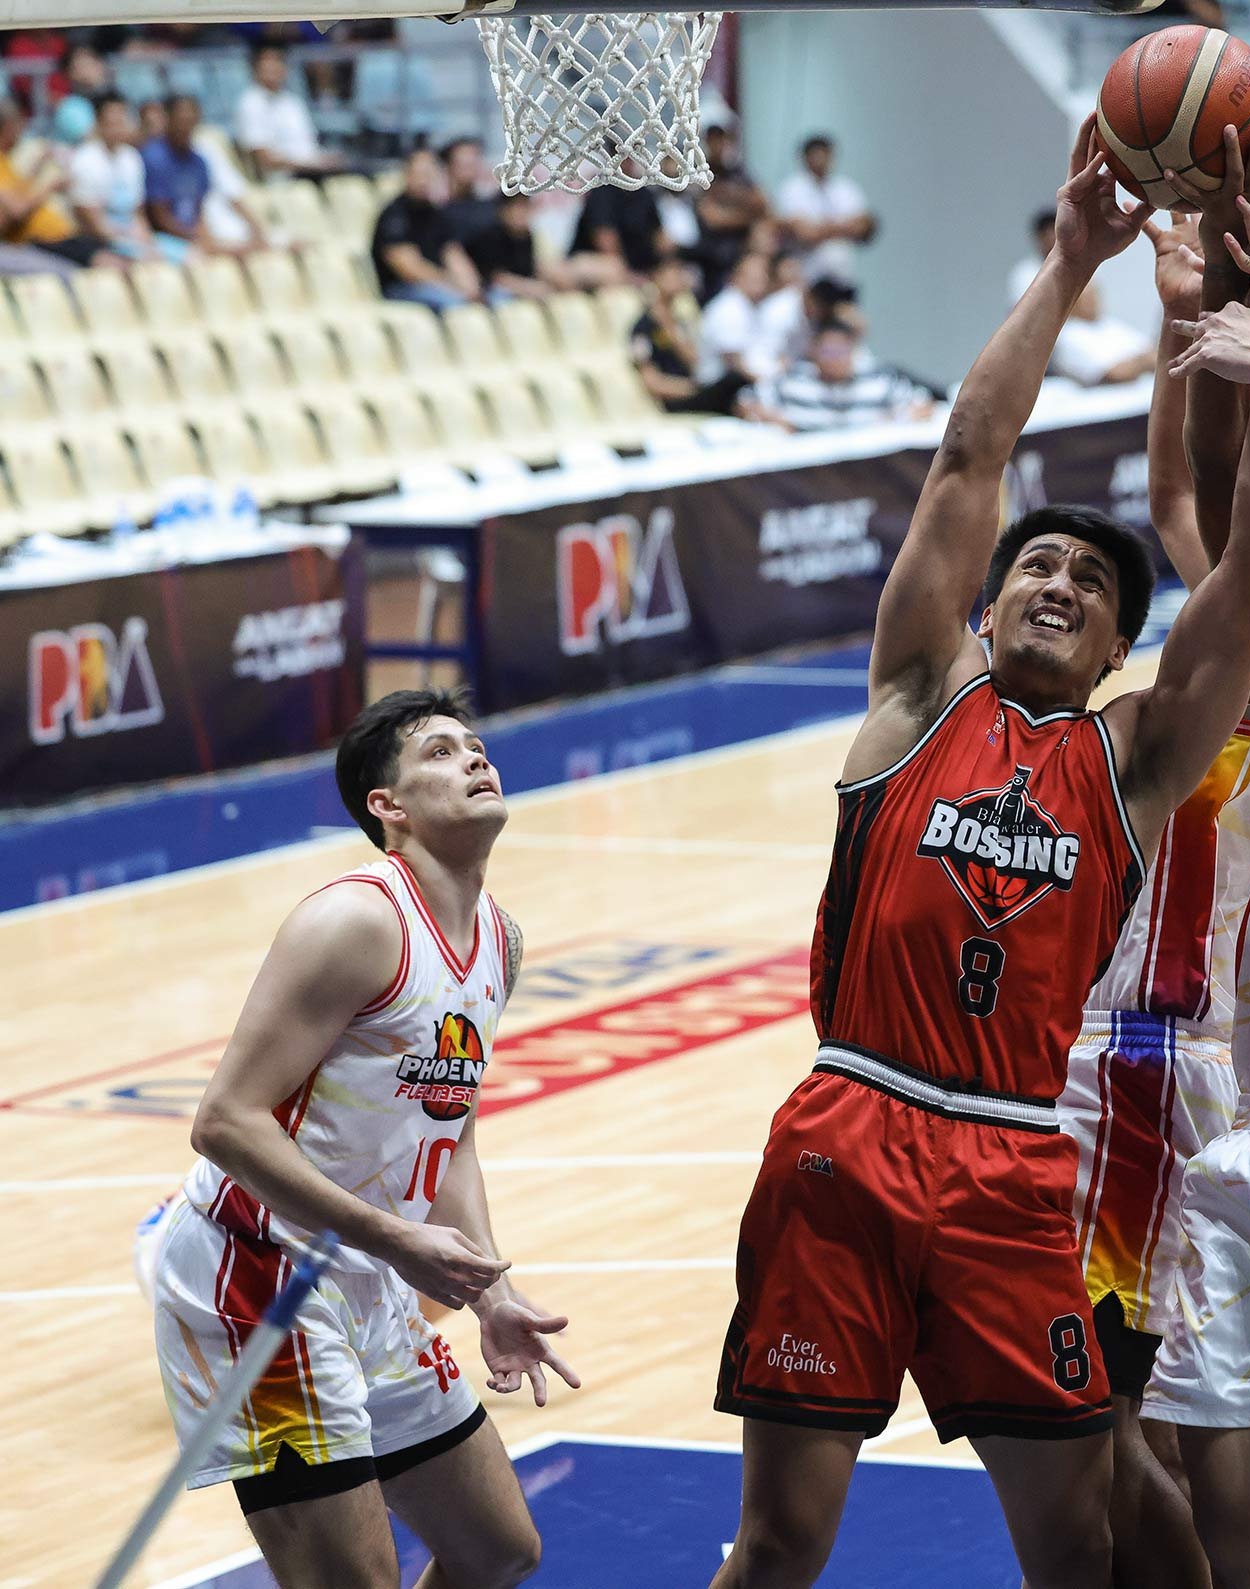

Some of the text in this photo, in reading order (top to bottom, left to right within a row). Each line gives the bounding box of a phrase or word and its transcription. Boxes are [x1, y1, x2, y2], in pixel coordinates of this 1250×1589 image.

[556, 506, 691, 657] PBA
[28, 616, 165, 746] PBA
[922, 803, 1080, 881] BOSSING
[977, 807, 1042, 835] Blawater
[958, 935, 1006, 1018] 8
[397, 1055, 488, 1084] PHOEN
[402, 1136, 459, 1204] 10
[797, 1150, 834, 1178] PBA
[767, 1347, 837, 1376] Organics
[780, 1333, 819, 1357] Ever
[1048, 1312, 1091, 1393] 8
